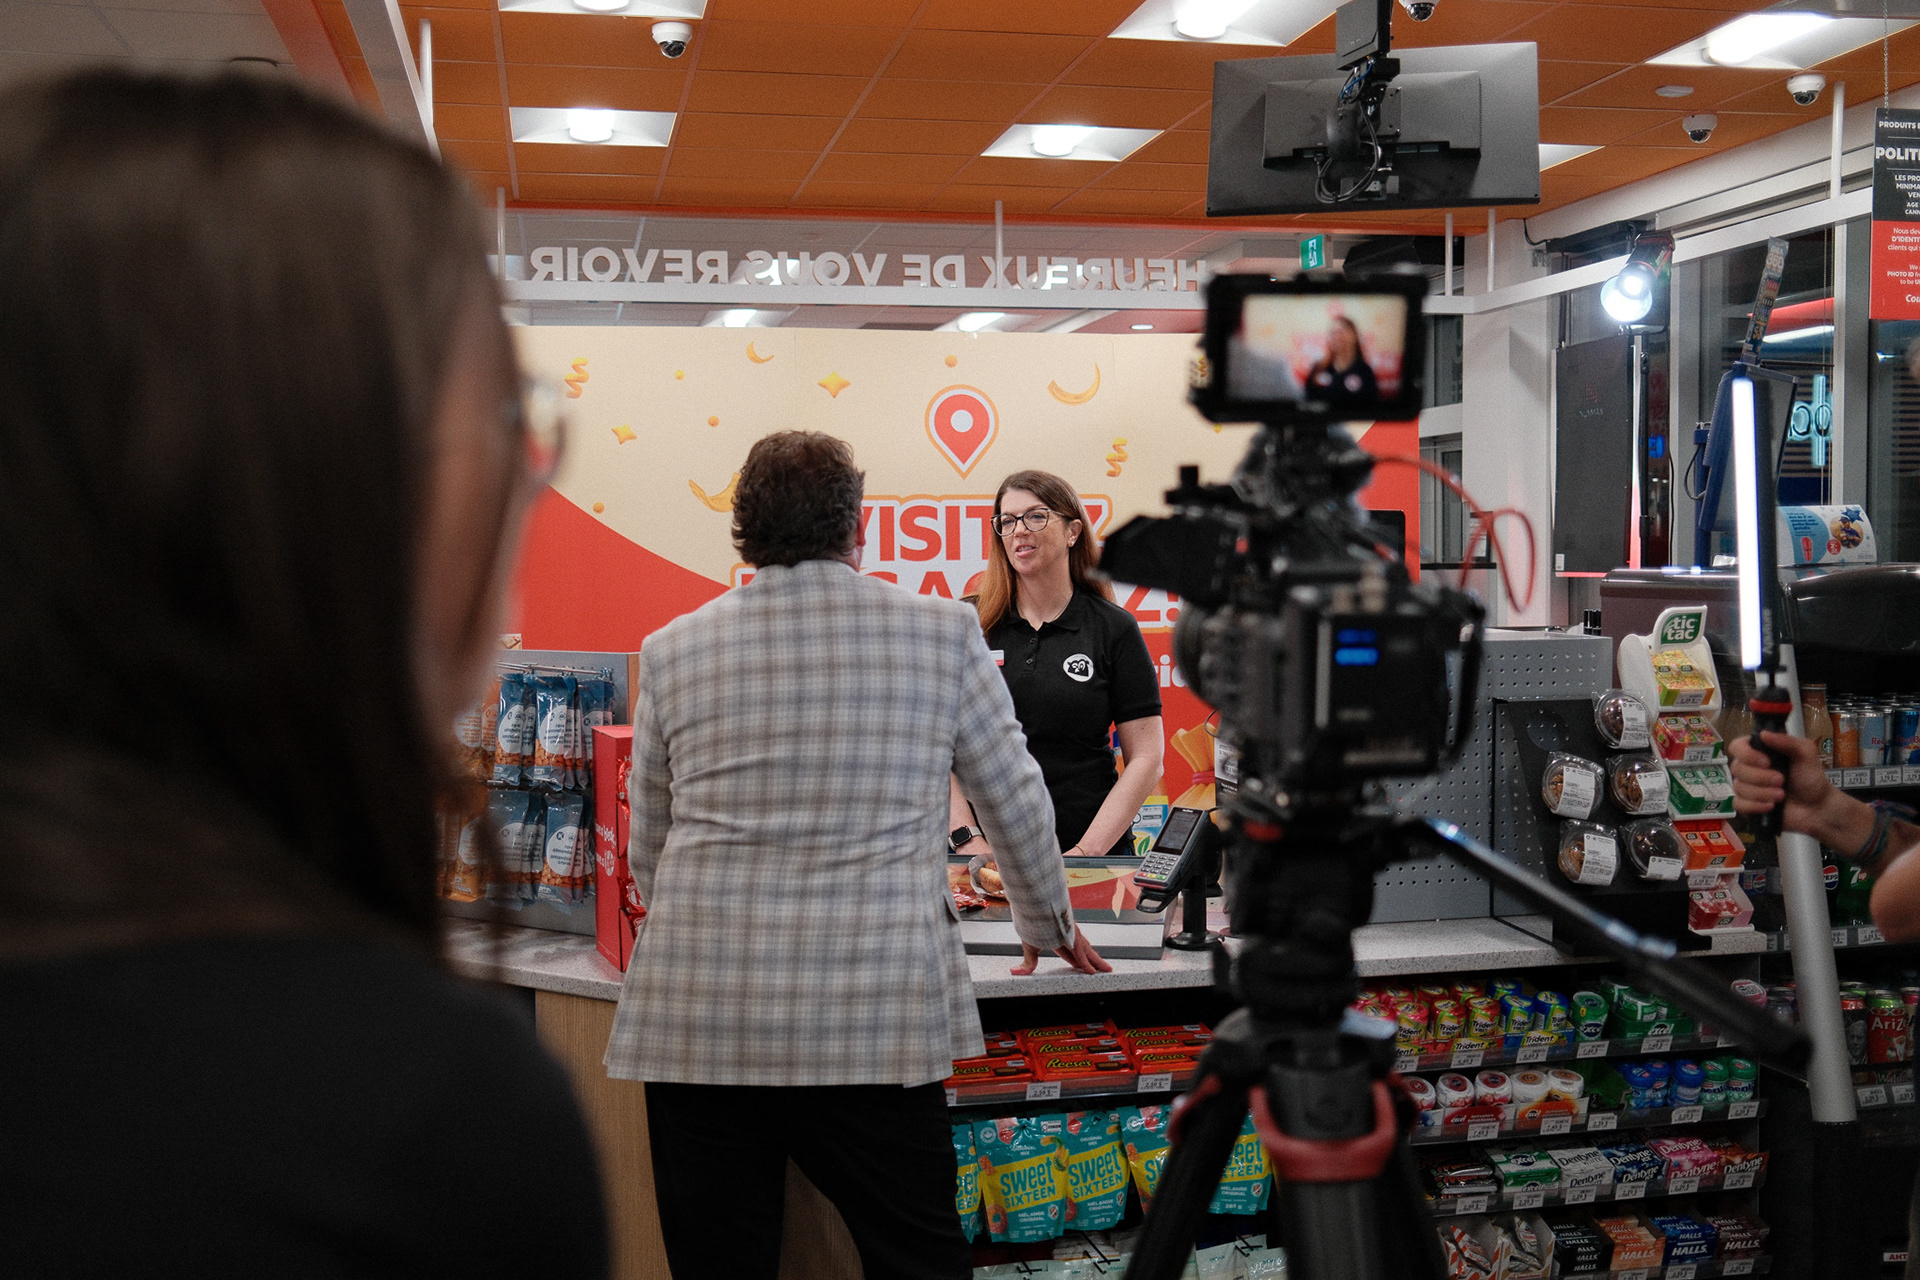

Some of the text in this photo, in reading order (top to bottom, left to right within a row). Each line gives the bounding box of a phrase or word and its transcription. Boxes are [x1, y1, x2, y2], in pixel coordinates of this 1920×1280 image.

[1879, 121, 1916, 129] PRODUITS
[1672, 616, 1695, 629] tic
[1666, 628, 1694, 640] tac
[1027, 1028, 1071, 1038] Reese's
[1126, 1028, 1168, 1038] Reese's
[1039, 1044, 1083, 1053] Reese's
[1456, 1041, 1485, 1050] Trident
[1046, 1058, 1092, 1068] Reese's
[1658, 1139, 1700, 1154] Dentyne
[1510, 1155, 1536, 1165] excel
[1558, 1150, 1600, 1166] Dentyne
[1610, 1149, 1650, 1166] Dentyne
[1670, 1161, 1716, 1178] Dentyne
[1723, 1156, 1763, 1174] Dentyne
[1570, 1171, 1606, 1187] Dentyne
[1622, 1165, 1659, 1182] Dentyne
[1073, 1173, 1123, 1198] SIXTEEN
[1005, 1185, 1056, 1209] SIXTEEN
[1672, 1245, 1707, 1256] HALLS
[1724, 1240, 1760, 1250] HALLS
[1620, 1250, 1655, 1260] HALLS
